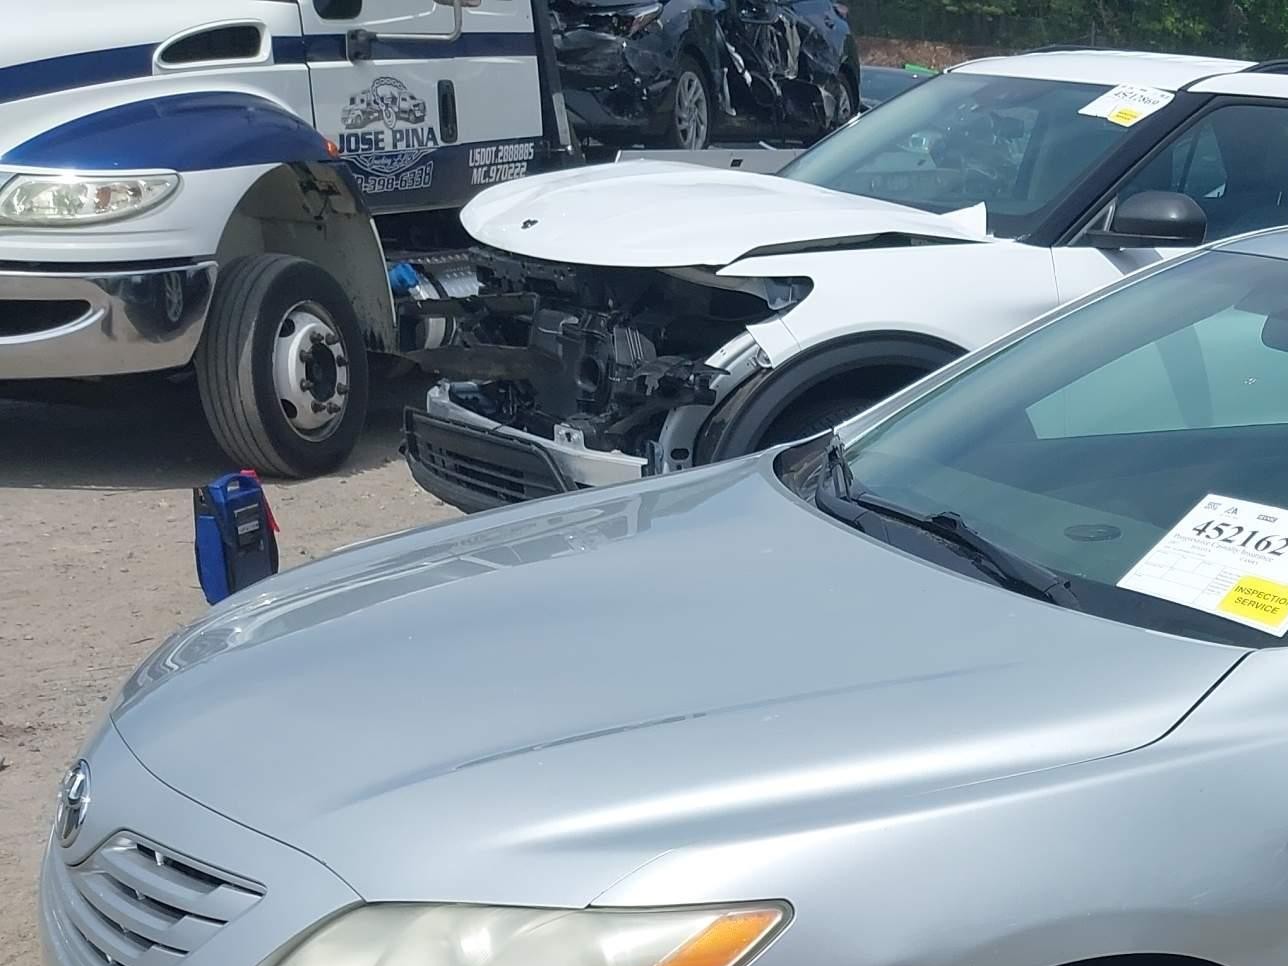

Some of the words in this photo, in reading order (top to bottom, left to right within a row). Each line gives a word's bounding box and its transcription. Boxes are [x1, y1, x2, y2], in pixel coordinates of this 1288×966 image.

[338, 131, 385, 154] JOSE
[392, 127, 440, 150] PINA
[471, 161, 527, 184] MC.970222
[1234, 597, 1281, 615] SERVICE
